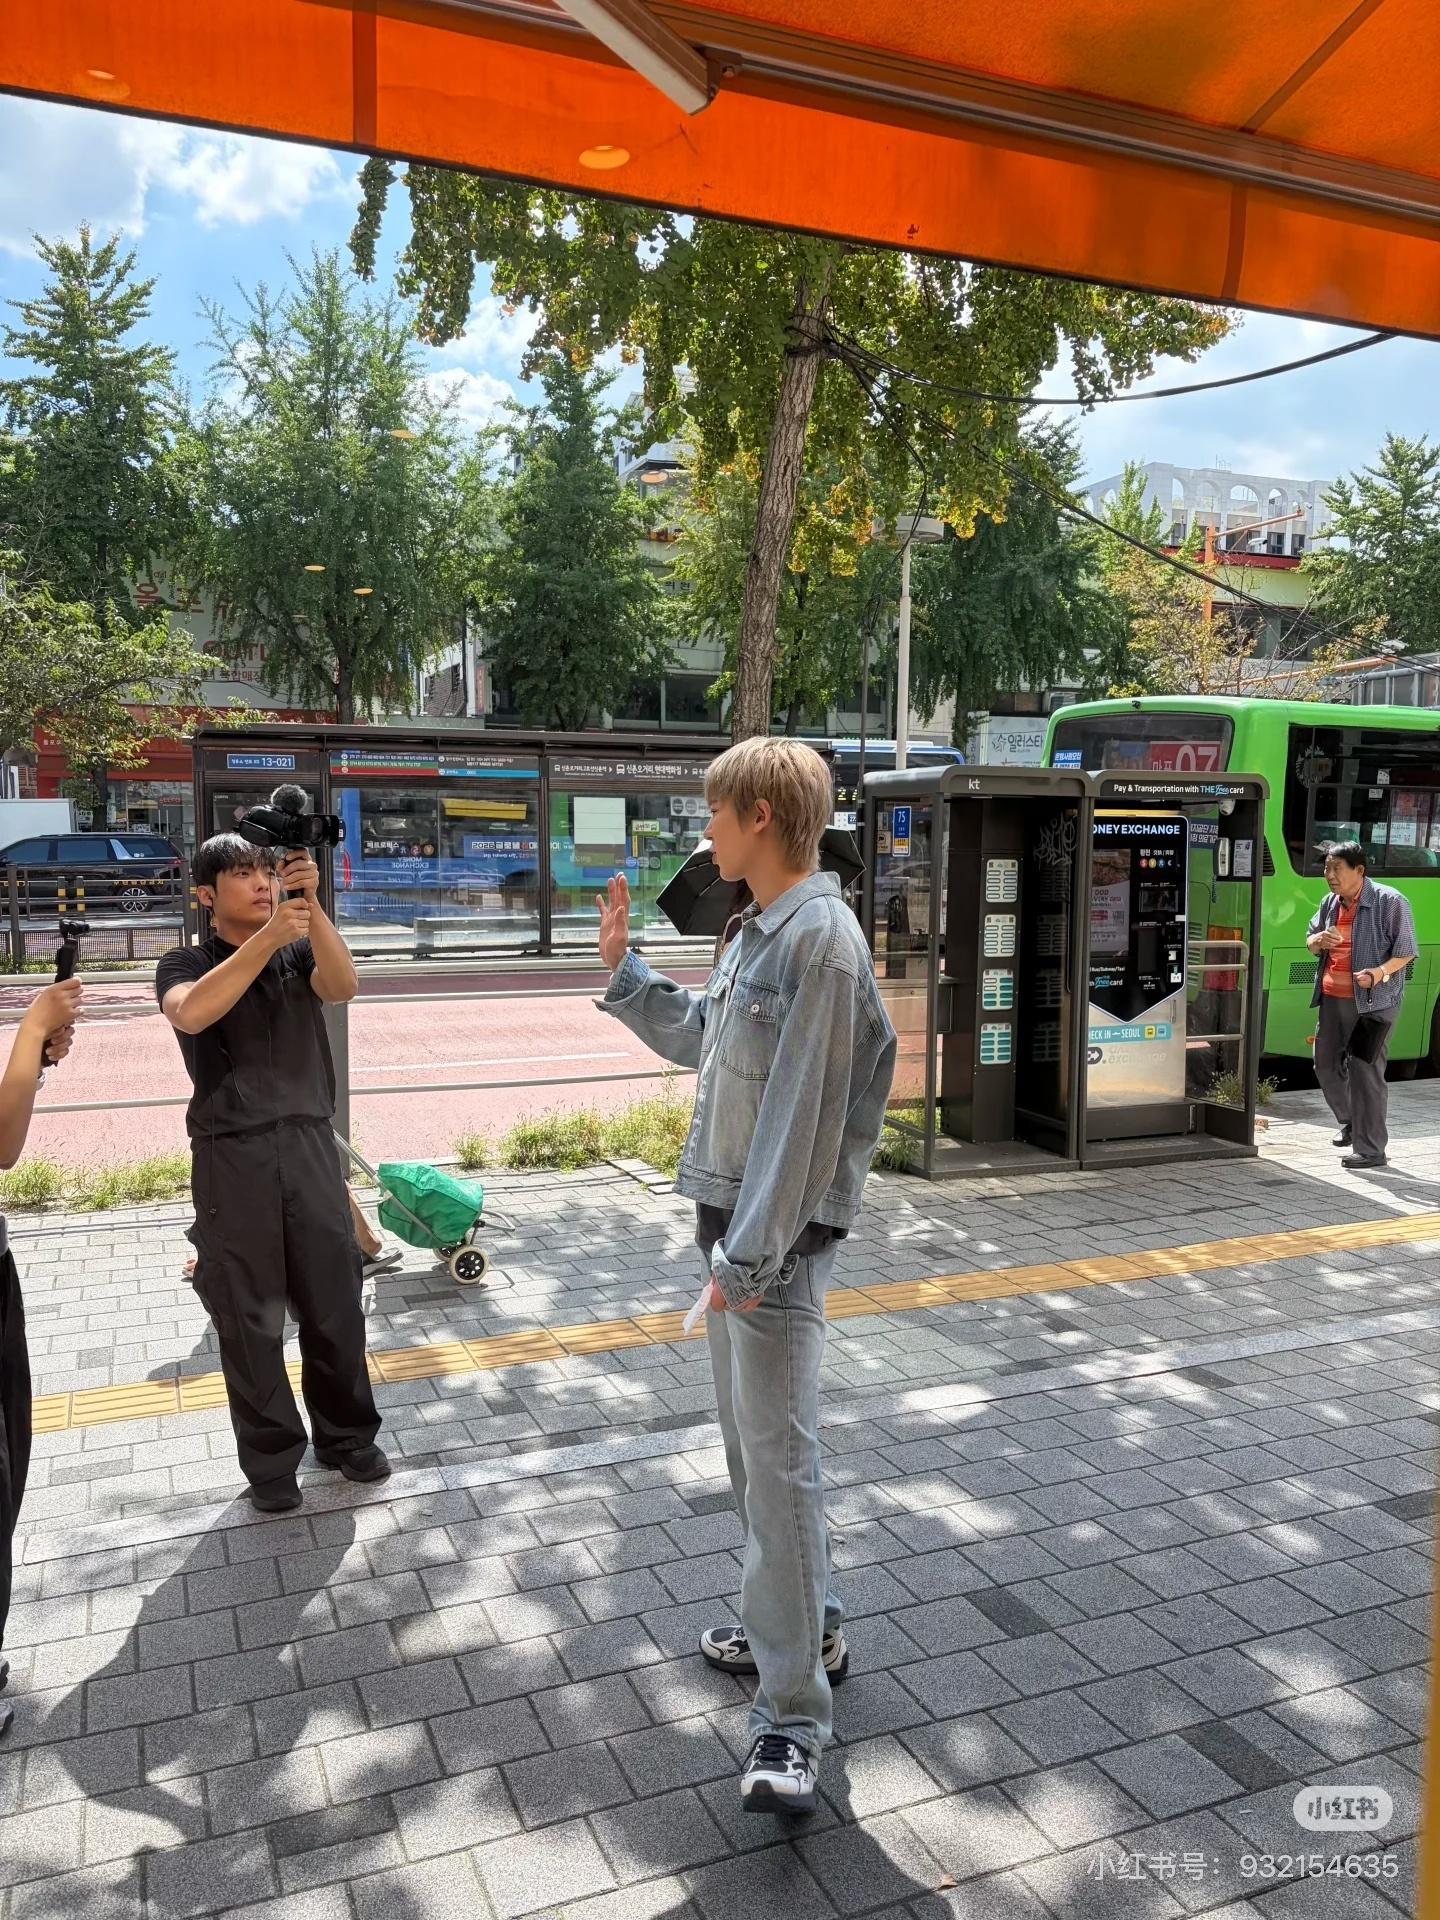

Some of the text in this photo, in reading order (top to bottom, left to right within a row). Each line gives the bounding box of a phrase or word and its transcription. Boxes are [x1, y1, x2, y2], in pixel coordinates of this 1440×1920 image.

[262, 757, 291, 767] 13-021
[968, 778, 981, 790] kt
[1113, 784, 1127, 794] Pay
[1127, 784, 1133, 792] &
[1134, 784, 1184, 797] Transportation
[1185, 785, 1199, 793] with
[1200, 785, 1215, 793] THE
[1229, 785, 1244, 794] card
[1092, 824, 1181, 835] ONEY EXCHANGE
[1109, 978, 1123, 986] card
[1120, 1028, 1140, 1038] SEOUL
